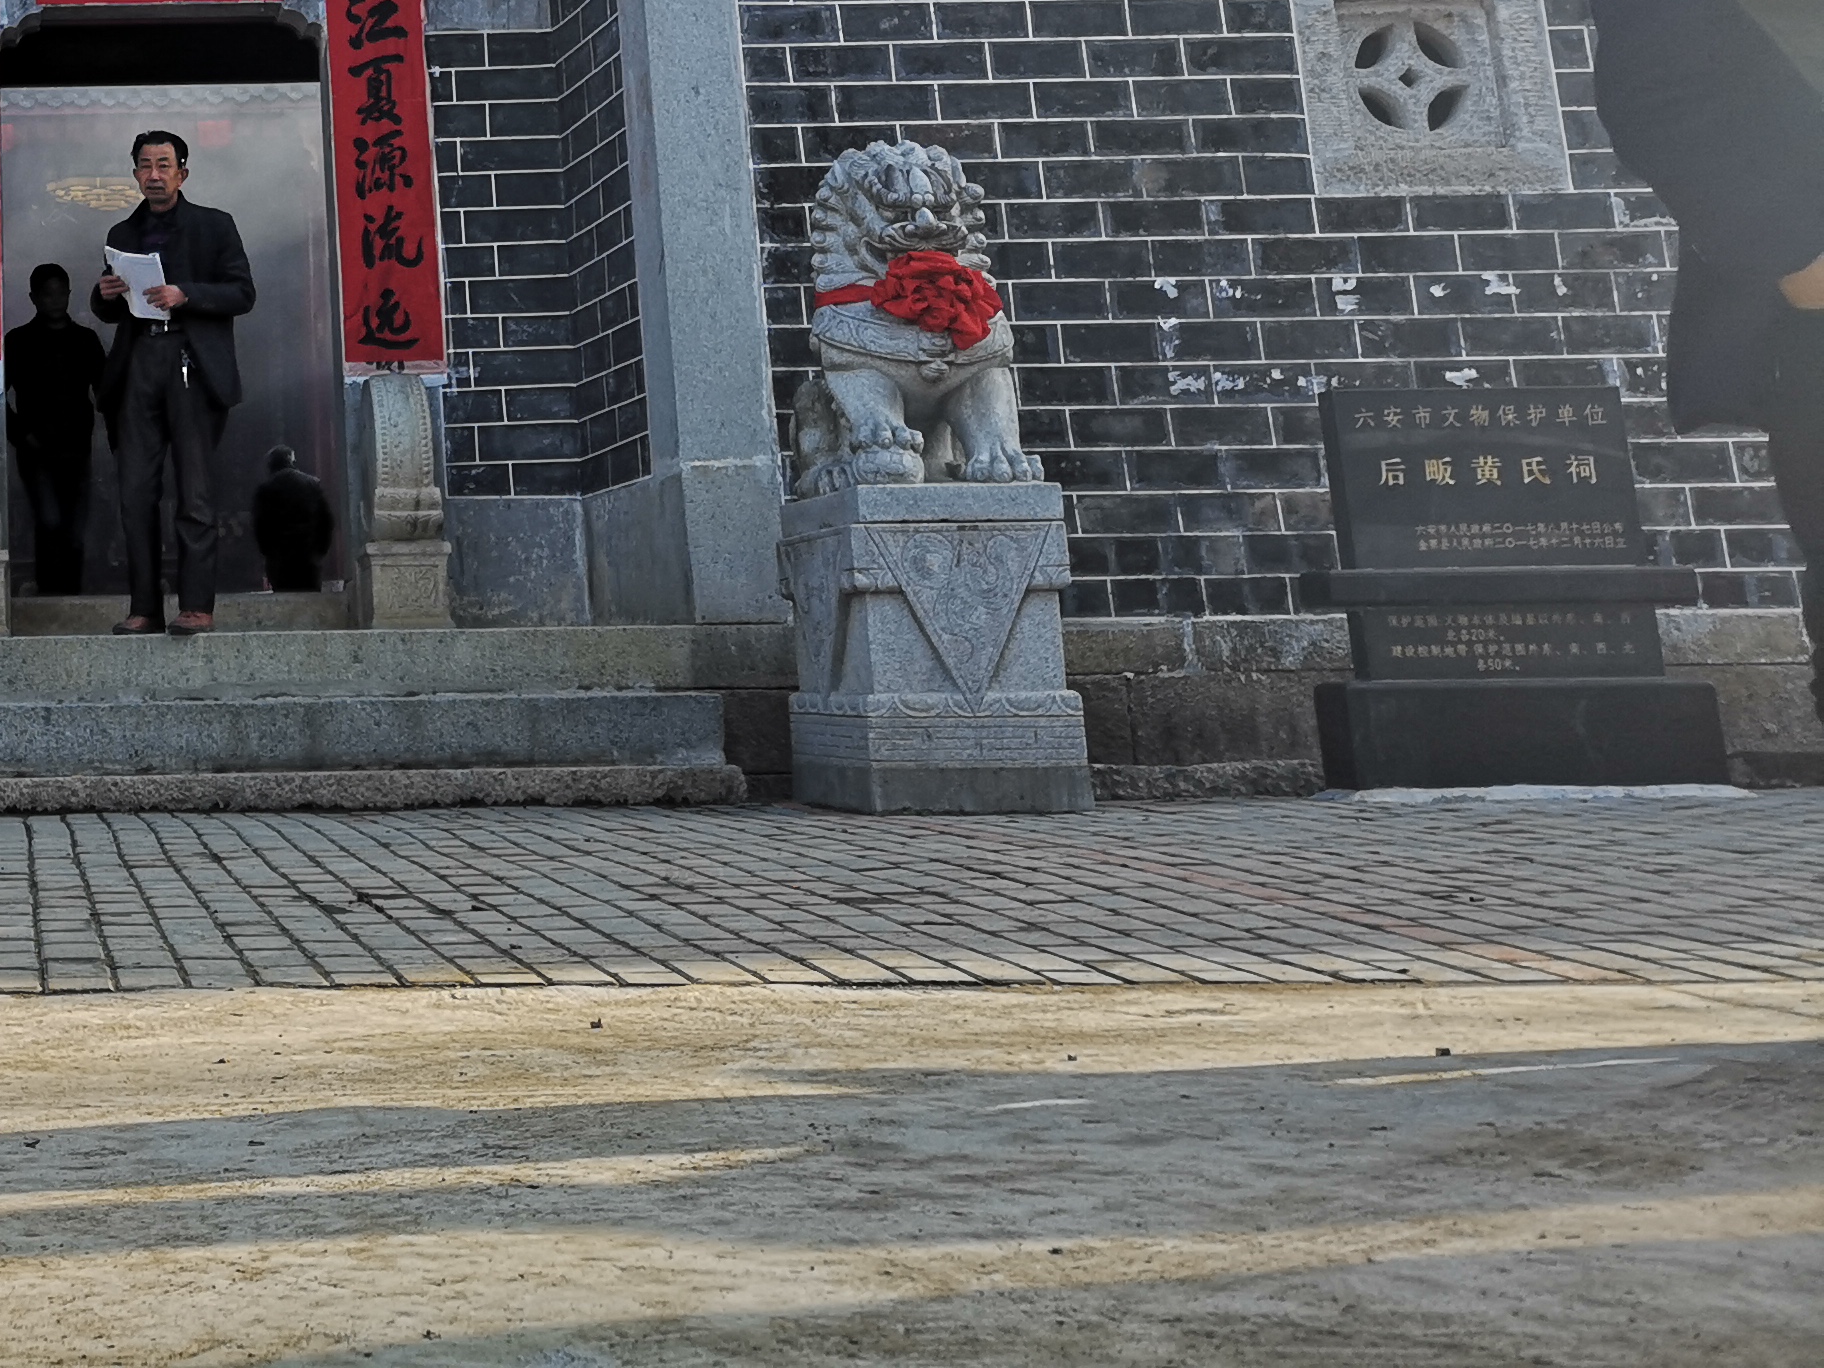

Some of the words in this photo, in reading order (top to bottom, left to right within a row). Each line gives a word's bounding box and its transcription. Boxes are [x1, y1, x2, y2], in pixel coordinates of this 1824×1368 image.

[1353, 402, 1608, 429] 六安市文物保护单位
[1378, 454, 1598, 487] 后畈黄氏祠
